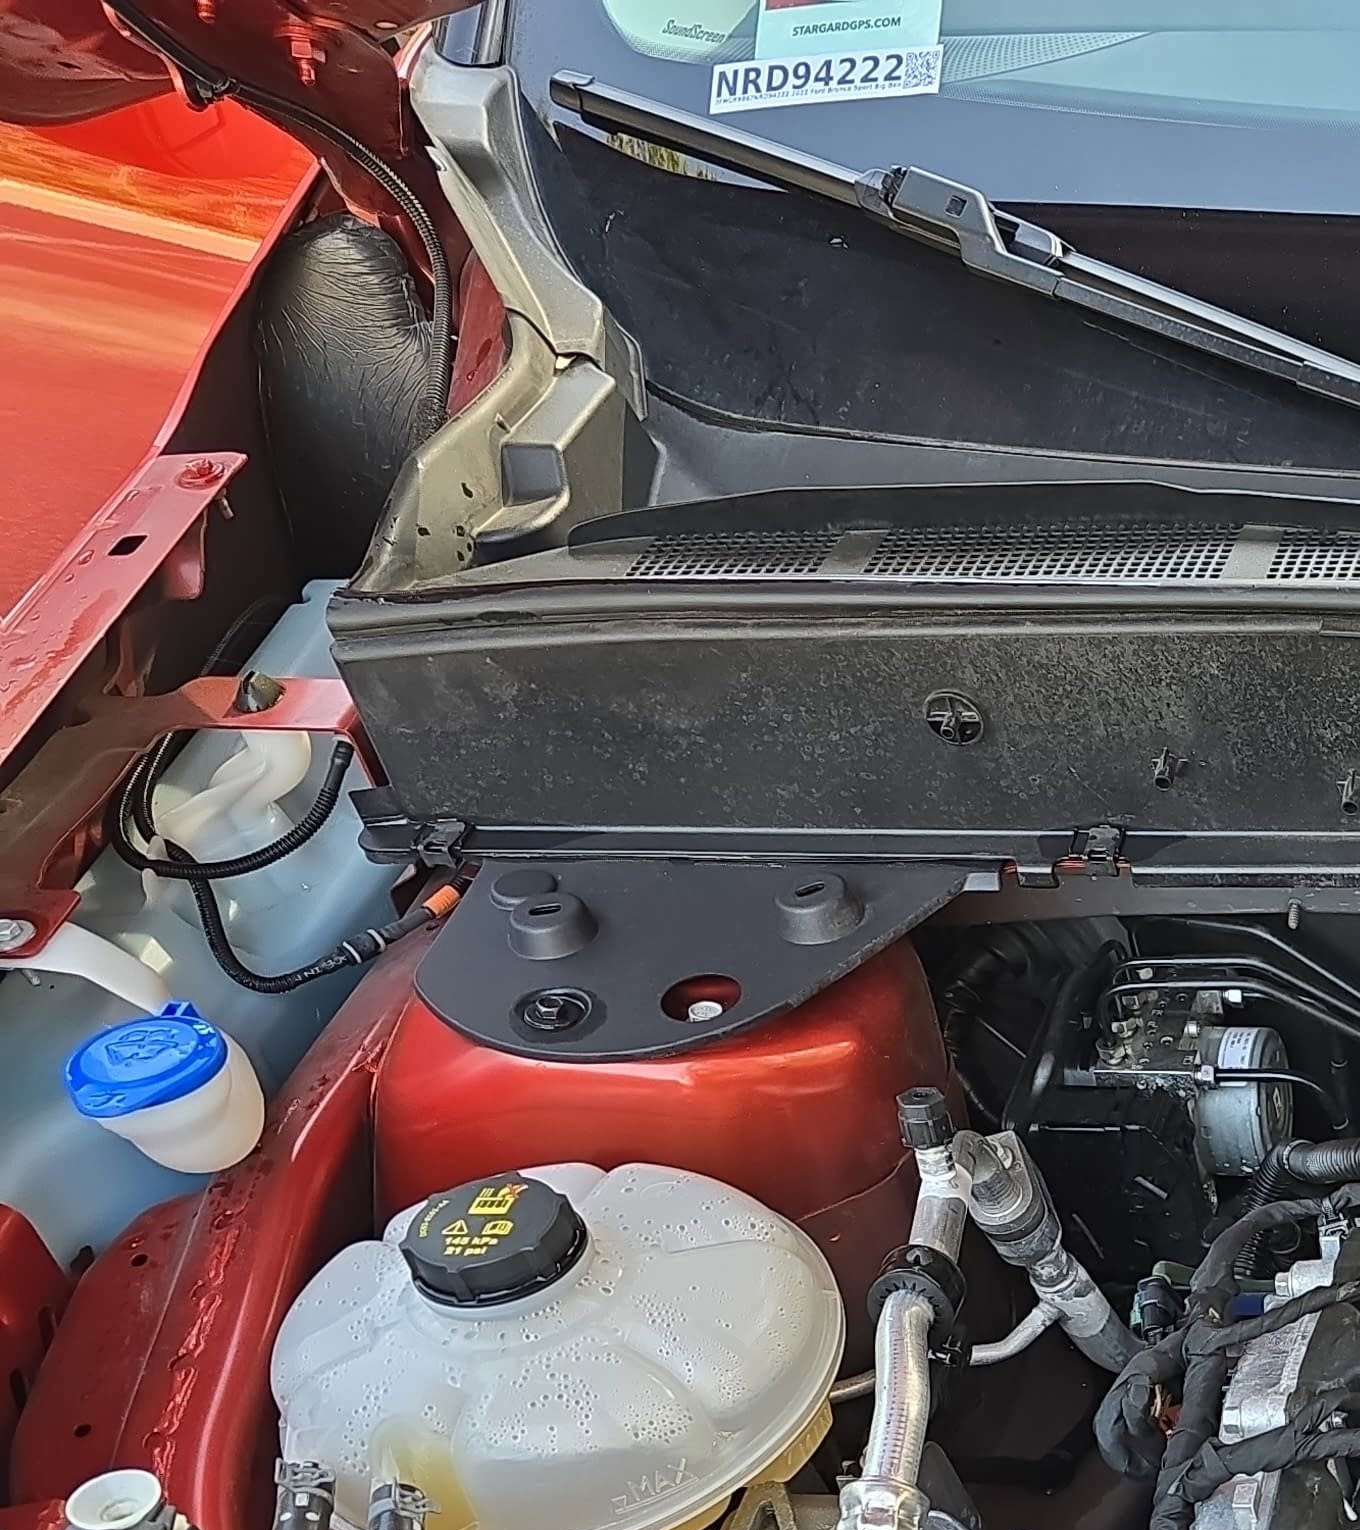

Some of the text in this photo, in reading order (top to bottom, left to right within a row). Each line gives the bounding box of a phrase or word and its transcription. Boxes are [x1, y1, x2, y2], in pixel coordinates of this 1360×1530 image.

[662, 19, 725, 43] SoundScreen
[792, 16, 902, 37] STARGARDGPS.COM
[716, 53, 904, 99] NRD94222
[810, 86, 826, 95] Ford
[853, 83, 873, 93] Sport
[874, 83, 887, 91] Big
[443, 1246, 488, 1257] 21 psi
[444, 1236, 499, 1246] 145 kPa
[626, 1457, 696, 1502] MAX
